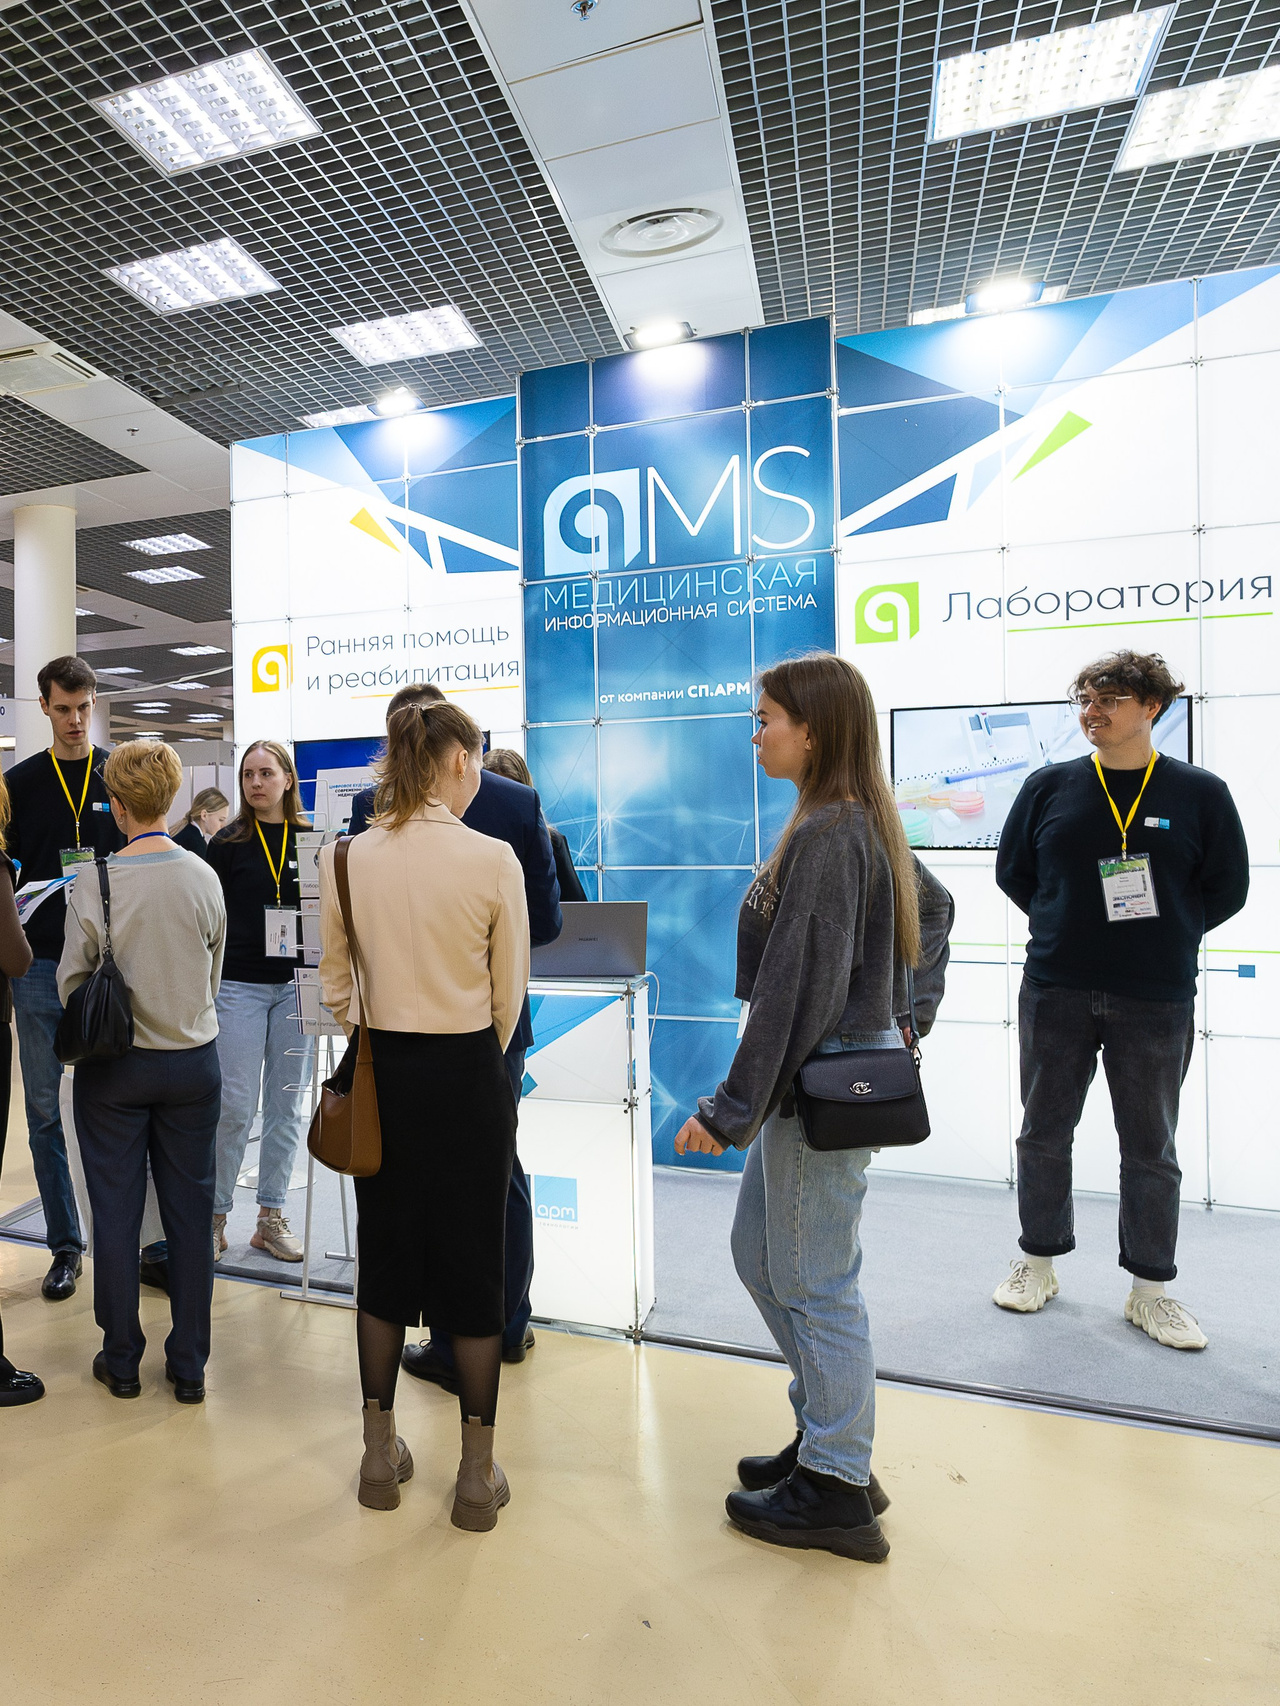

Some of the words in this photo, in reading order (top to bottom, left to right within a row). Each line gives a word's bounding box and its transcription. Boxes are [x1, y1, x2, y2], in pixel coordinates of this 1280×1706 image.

[544, 558, 817, 612] МЕДИЦИНСКАЯ
[942, 575, 1273, 623] Лаборатория
[544, 603, 718, 632] ИНФОРМАЦИОННАЯ
[727, 593, 817, 618] СИСТЕМА
[307, 634, 394, 657] Ранняя
[403, 625, 510, 649] помощь
[307, 675, 320, 691] и
[328, 661, 520, 695] реабилитация
[599, 693, 613, 703] от
[617, 689, 684, 703] компании
[687, 682, 751, 699] СП.АРМ
